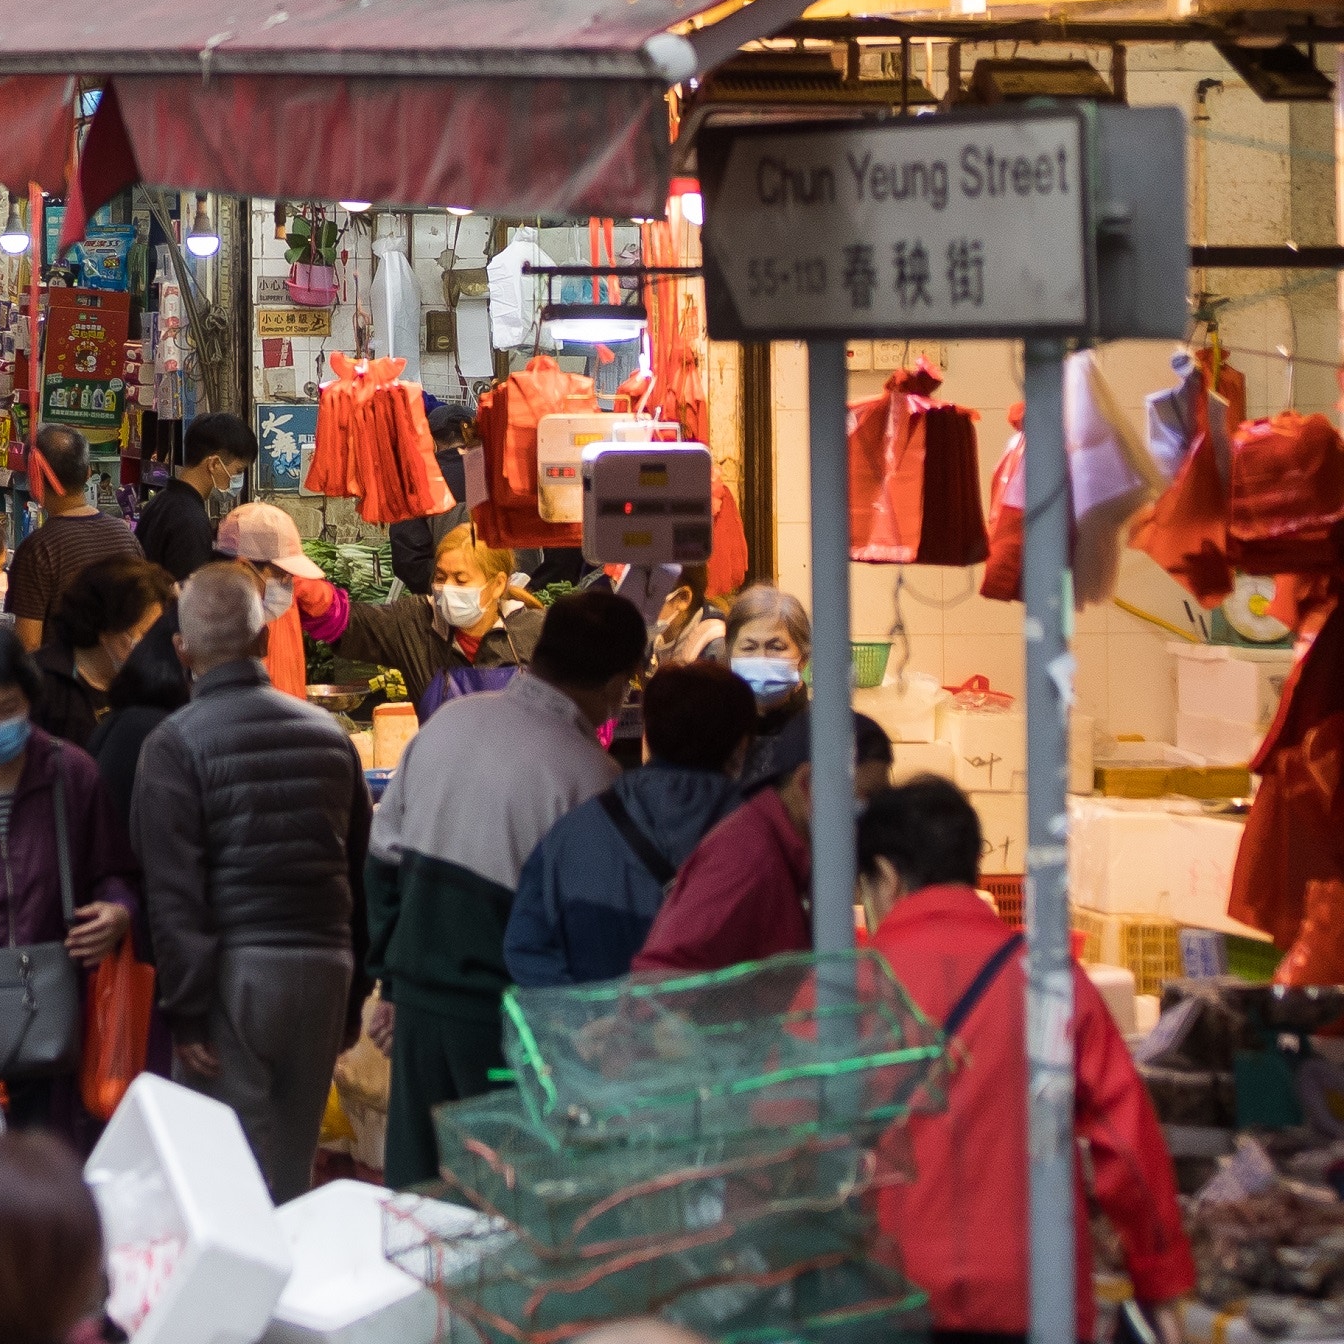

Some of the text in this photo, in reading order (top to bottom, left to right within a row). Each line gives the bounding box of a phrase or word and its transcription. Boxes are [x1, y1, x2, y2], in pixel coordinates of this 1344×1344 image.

[756, 143, 1069, 211] Chun Yeung Street
[842, 240, 985, 309] 春秧街
[262, 313, 310, 324] 小心梯級
